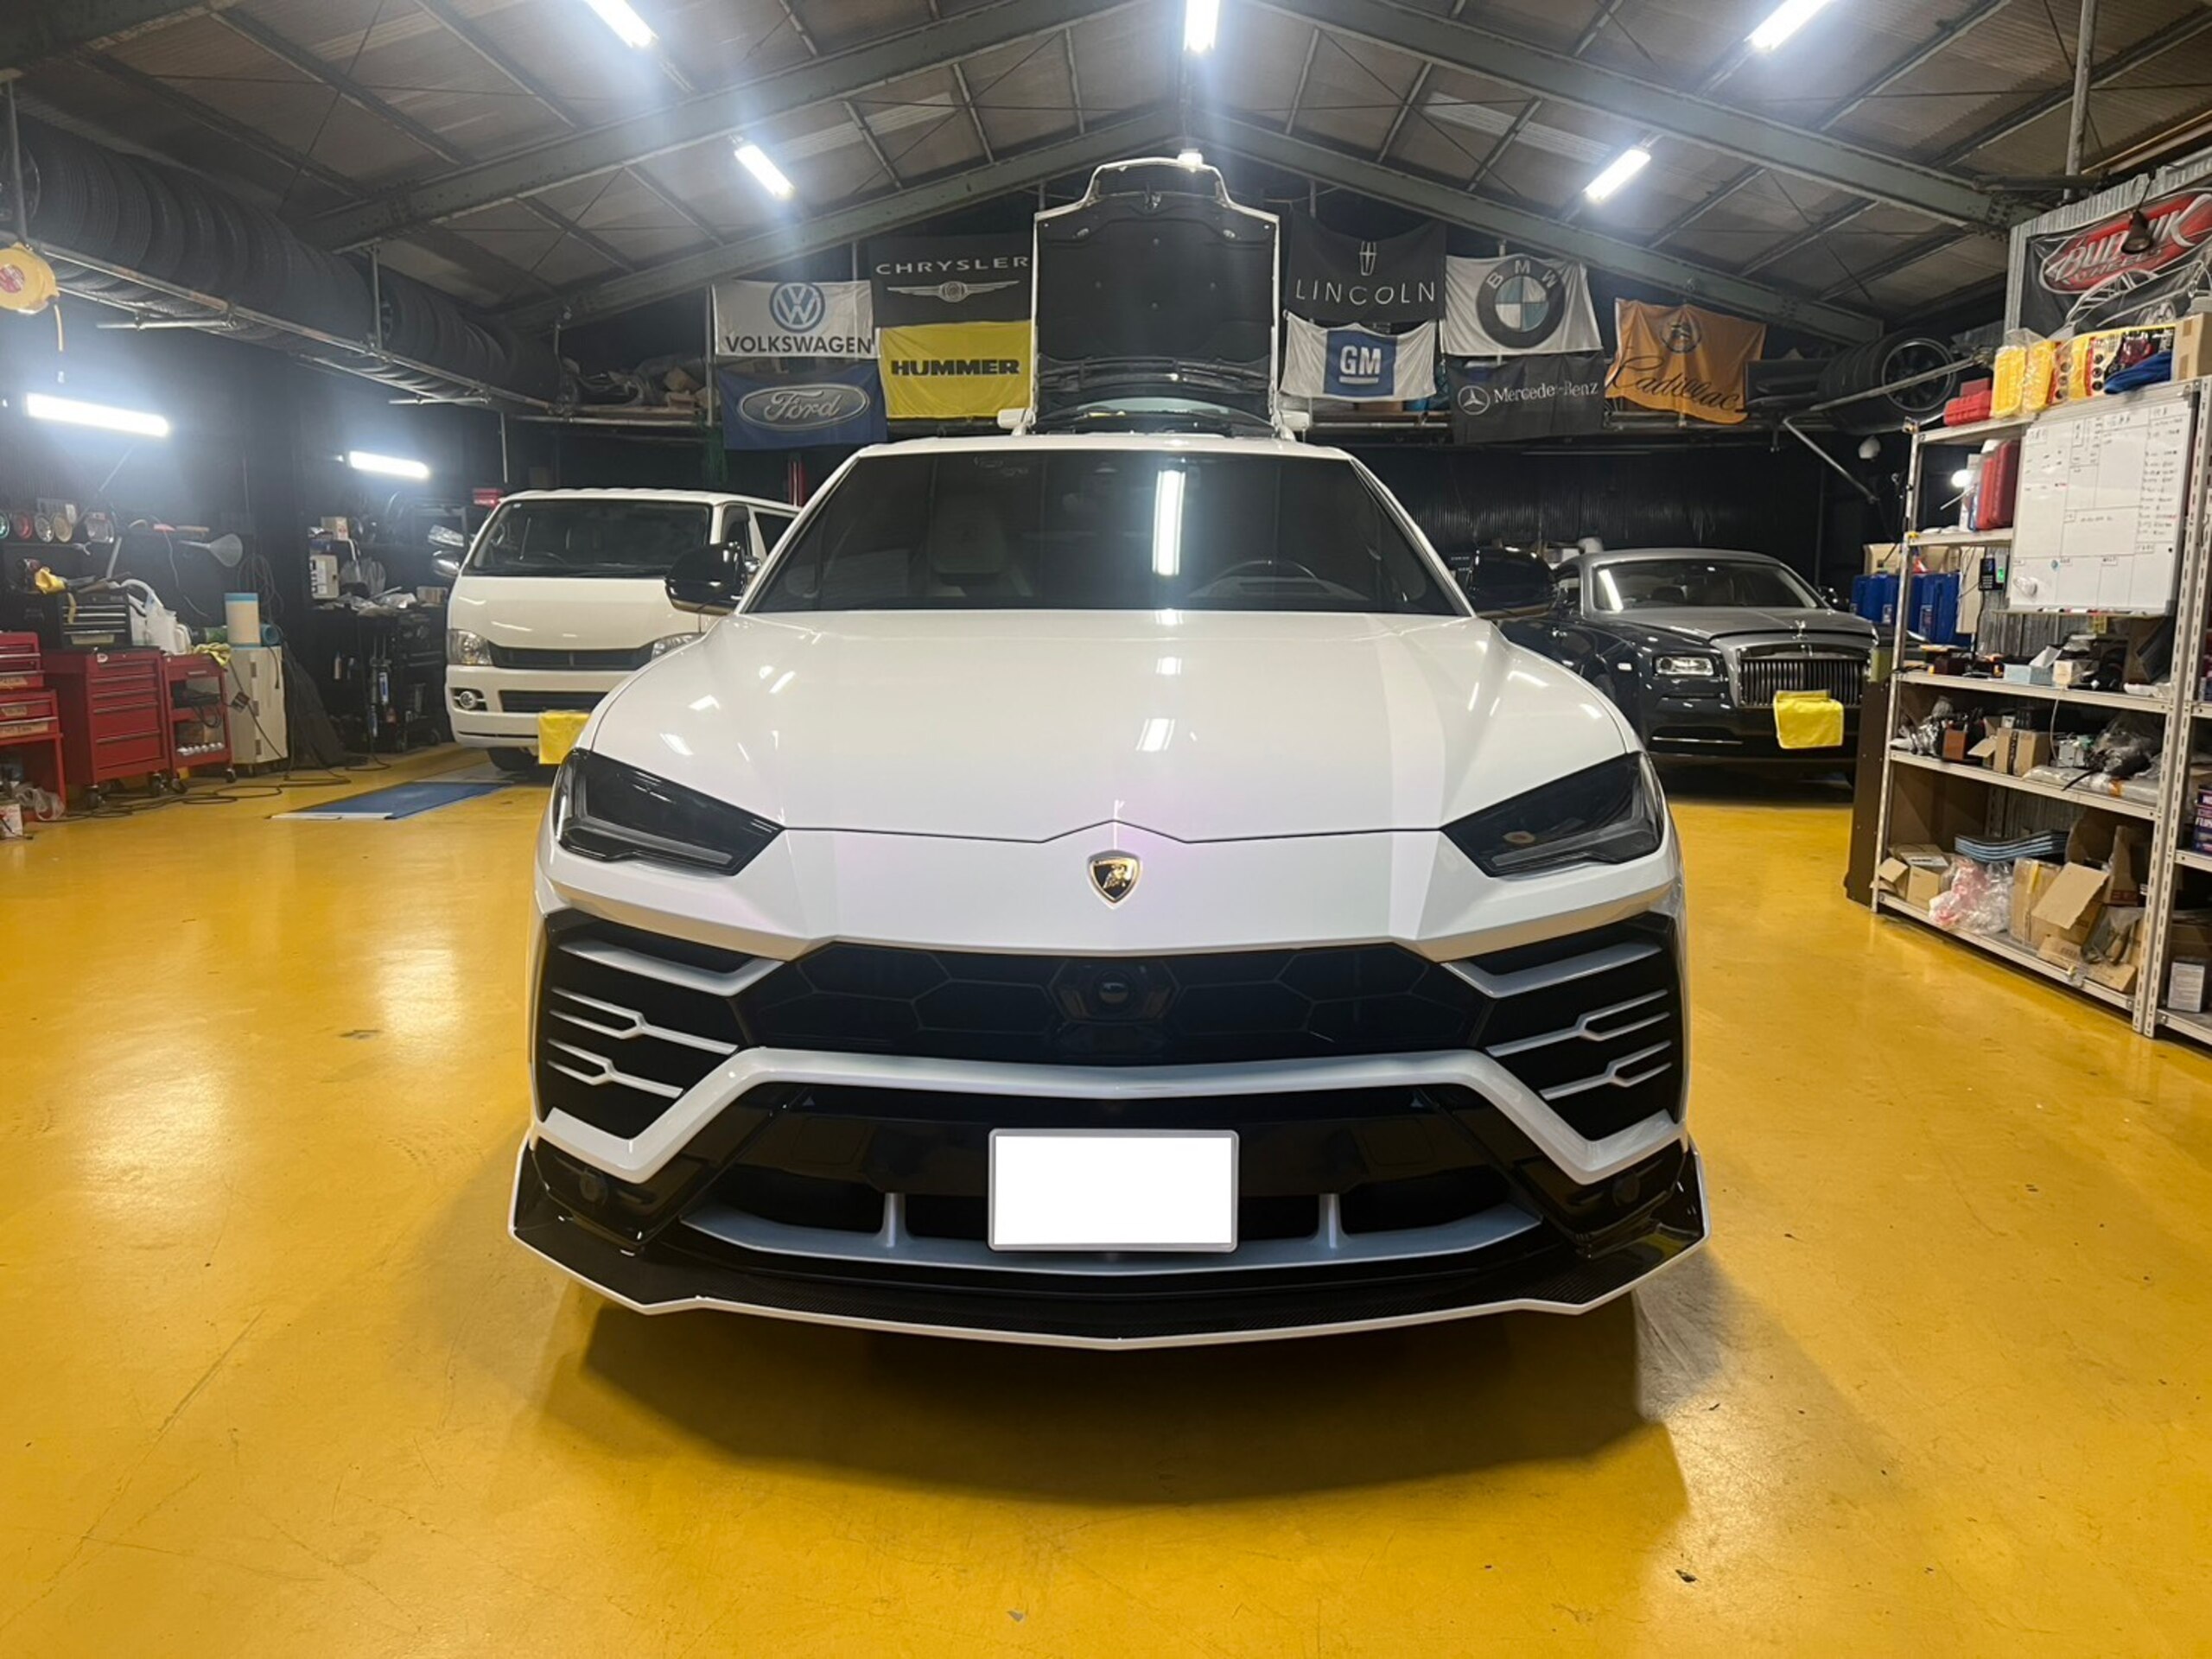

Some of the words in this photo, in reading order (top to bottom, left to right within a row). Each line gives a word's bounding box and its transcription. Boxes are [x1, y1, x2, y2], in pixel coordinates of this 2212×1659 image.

[875, 256, 1029, 276] CHRYSLER
[1486, 259, 1559, 289] BMW
[1295, 278, 1435, 306] LINCOLN
[725, 334, 872, 354] VOLKSWAGEN
[891, 359, 1020, 376] HUMMER
[1339, 345, 1382, 375] GM
[1493, 380, 1599, 404] Mercede-Benz
[1612, 355, 1744, 412] Cadillac
[764, 390, 842, 422] Ford
